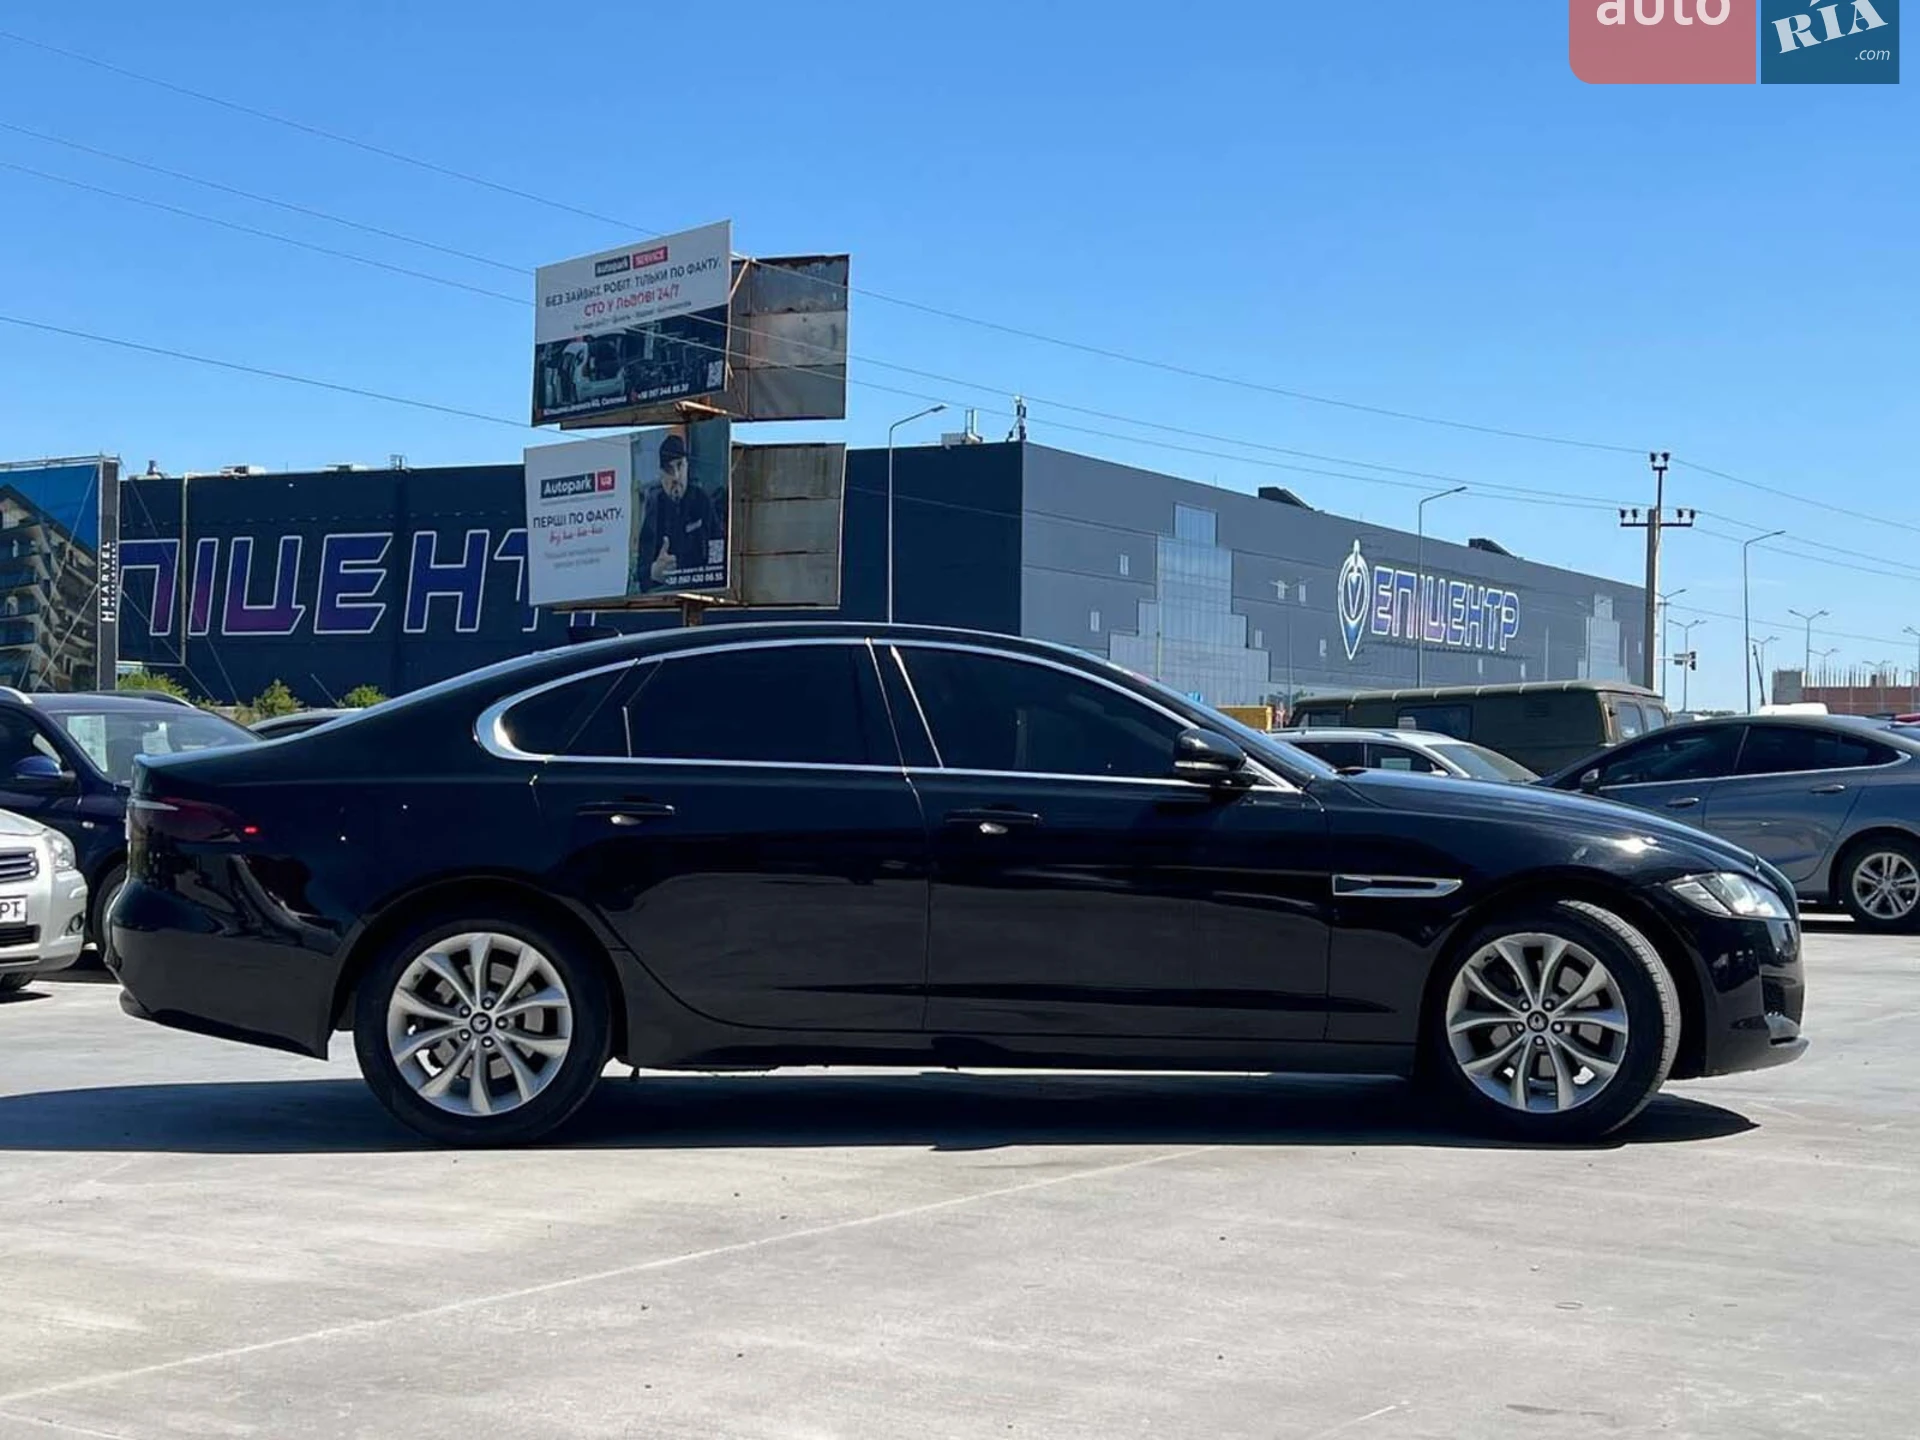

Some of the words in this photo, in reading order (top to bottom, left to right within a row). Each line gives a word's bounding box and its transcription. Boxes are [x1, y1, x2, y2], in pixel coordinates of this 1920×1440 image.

[670, 265, 685, 278] ПО
[584, 301, 606, 316] СТО
[656, 283, 680, 300] 24/7
[543, 475, 593, 496] Autopark
[533, 514, 567, 529] ПЕРШІ
[568, 511, 584, 524] ПО
[1371, 565, 1520, 652] ЕПІЦЕНТР
